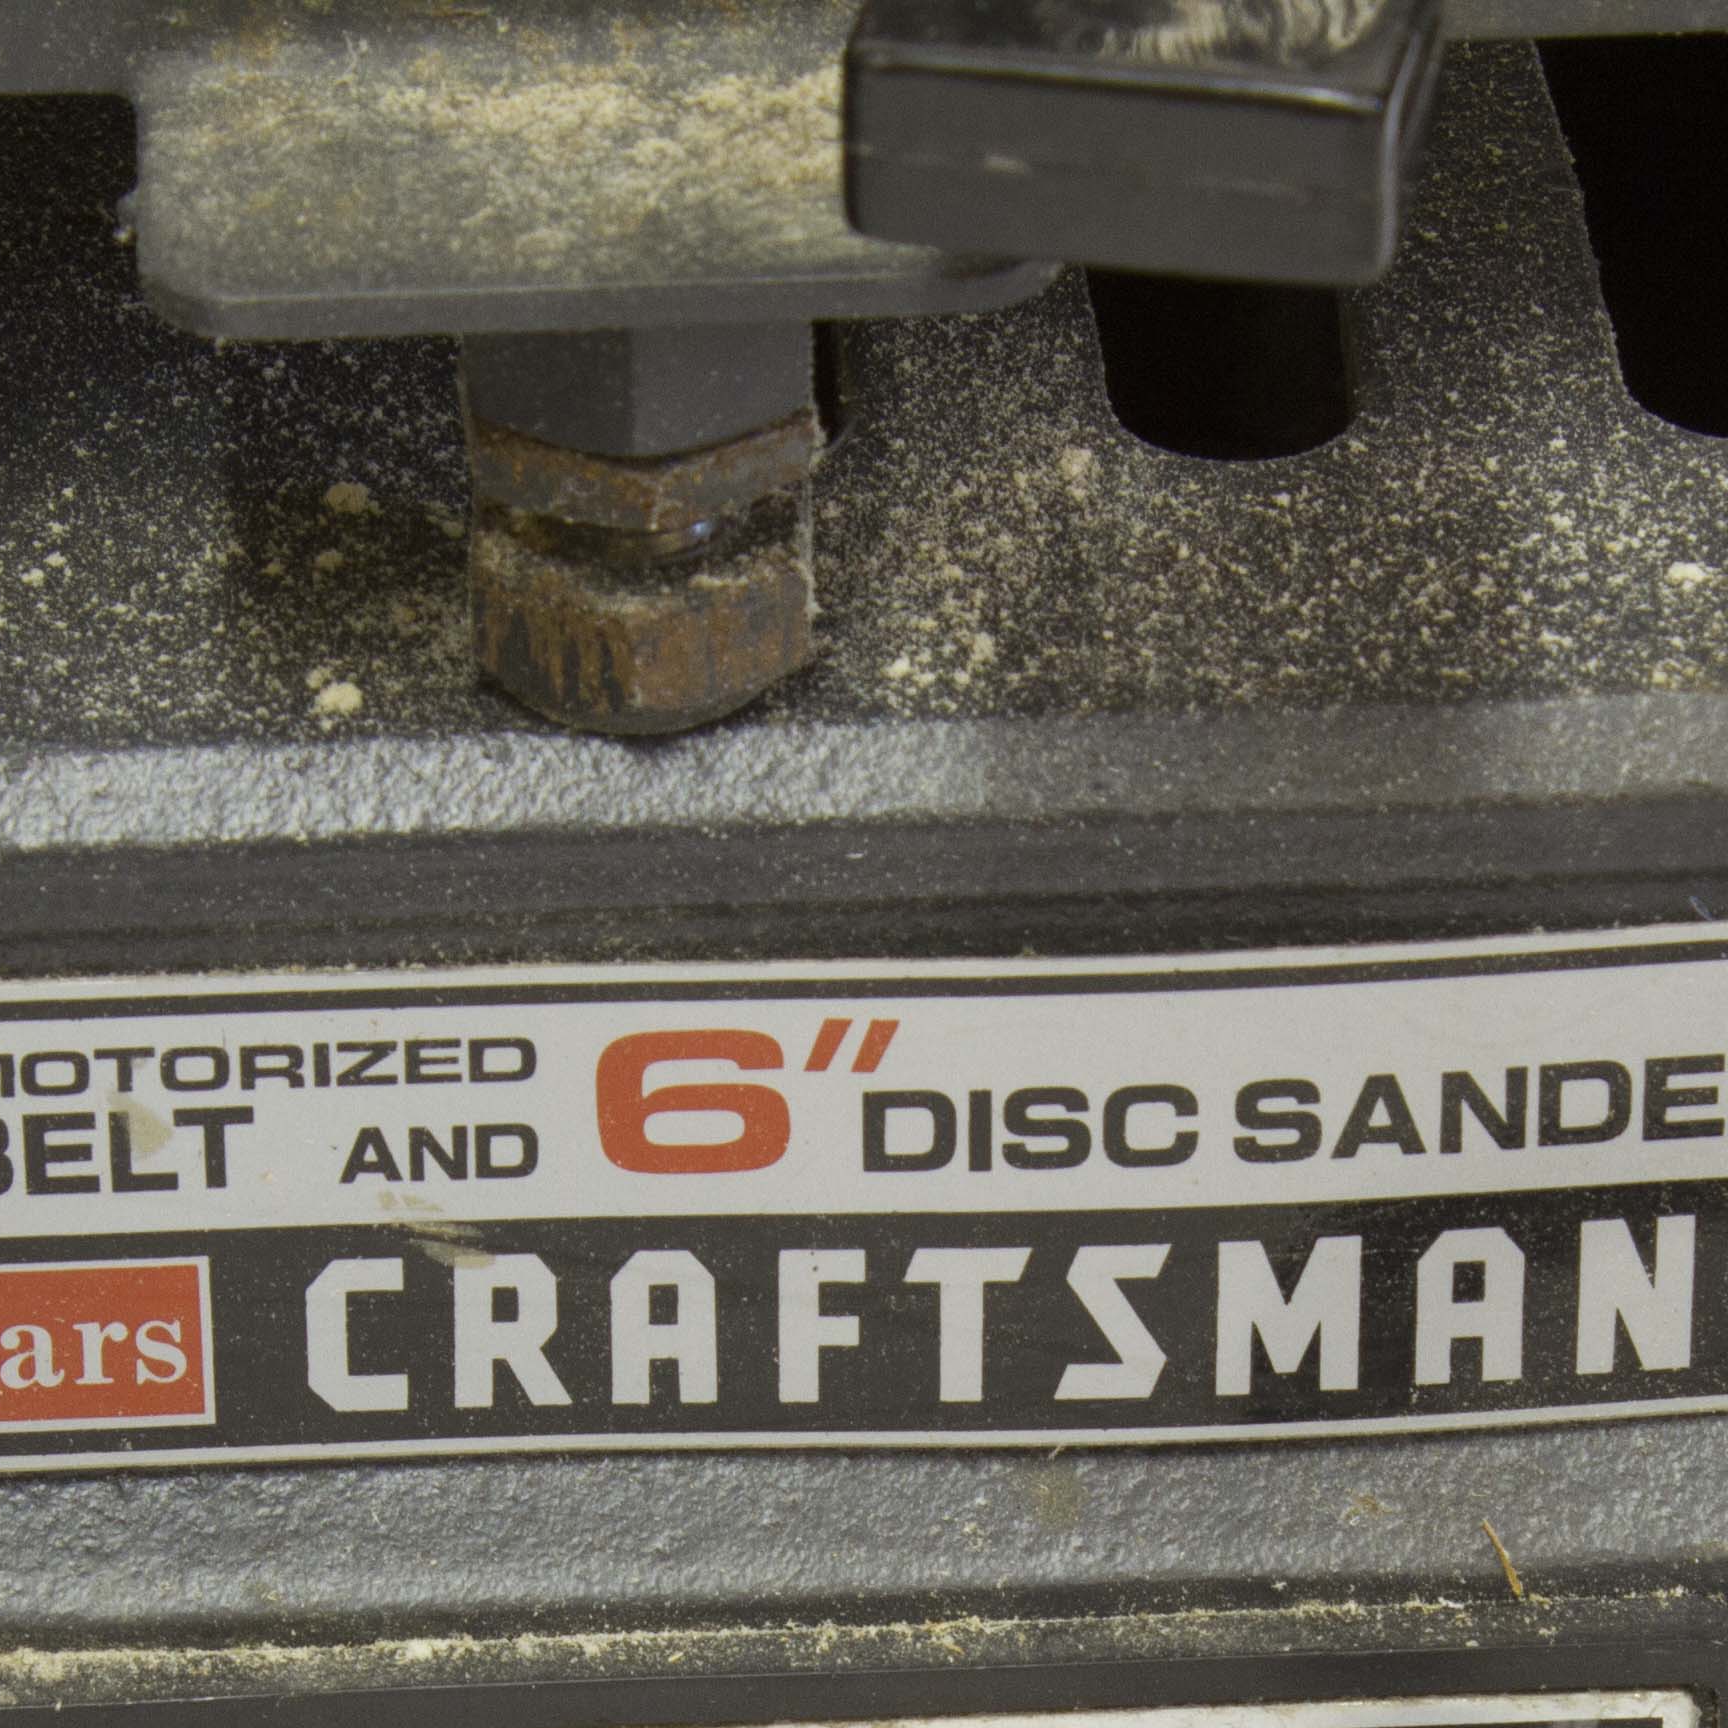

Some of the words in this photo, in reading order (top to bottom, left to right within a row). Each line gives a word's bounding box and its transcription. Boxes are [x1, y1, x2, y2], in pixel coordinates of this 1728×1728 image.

[337, 1123, 540, 1185] AND
[860, 1083, 1200, 1174] DISC
[305, 1213, 1697, 1412] CRAFTSMAN
